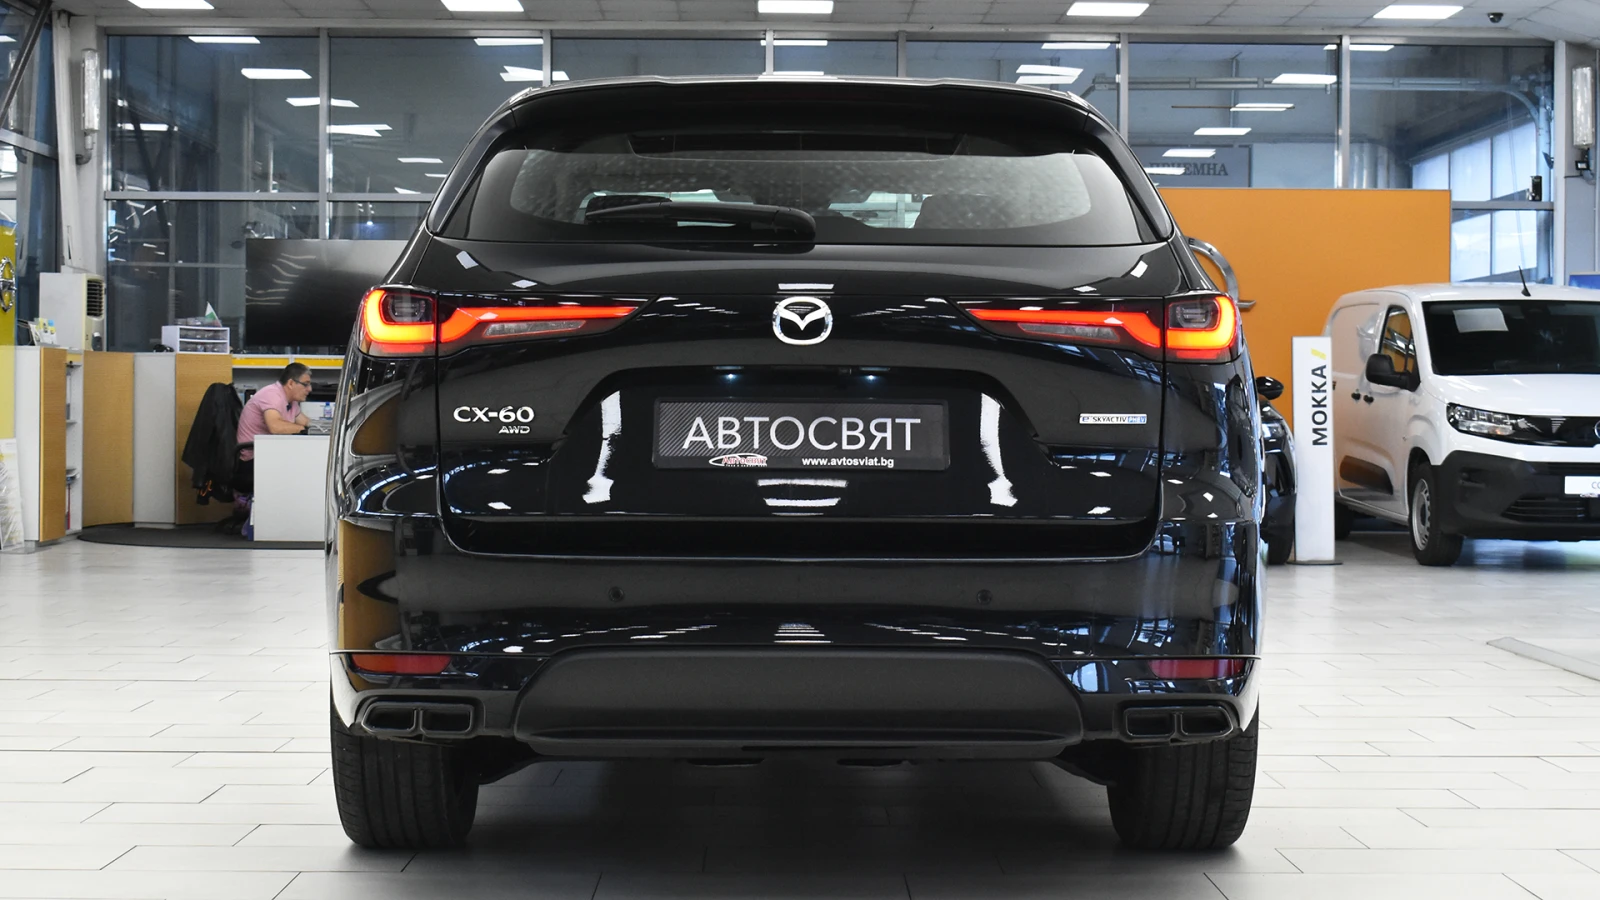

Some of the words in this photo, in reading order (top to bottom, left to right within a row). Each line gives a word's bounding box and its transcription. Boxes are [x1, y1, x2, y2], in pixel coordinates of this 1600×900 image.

[453, 405, 535, 423] CX-60
[1311, 364, 1328, 446] MOKKA
[498, 425, 531, 434] AWD
[682, 416, 921, 451] АВТОСВЯТ
[801, 456, 895, 469] www.avtosviat.bg
